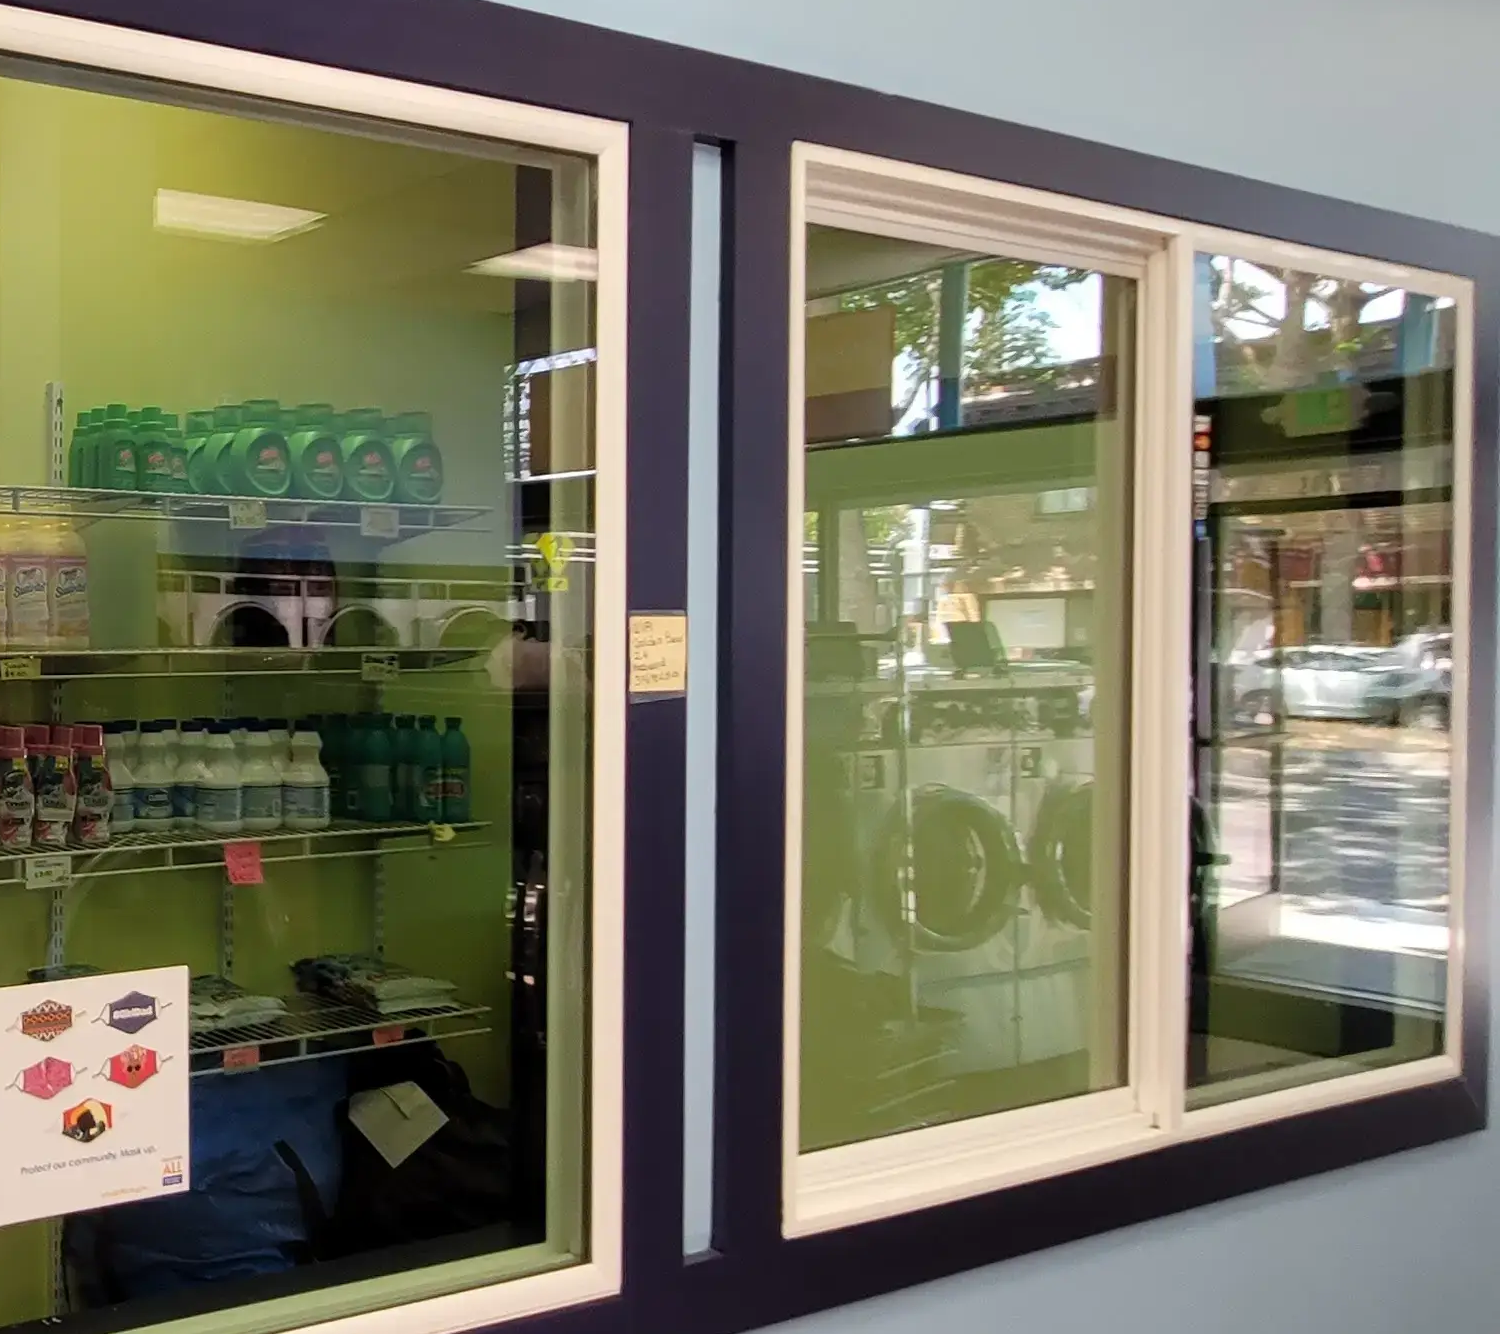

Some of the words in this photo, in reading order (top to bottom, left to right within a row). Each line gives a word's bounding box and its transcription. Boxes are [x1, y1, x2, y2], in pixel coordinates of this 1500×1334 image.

[20, 1161, 51, 1176] Protect
[52, 1161, 67, 1171] our
[163, 1160, 183, 1175] ALL
